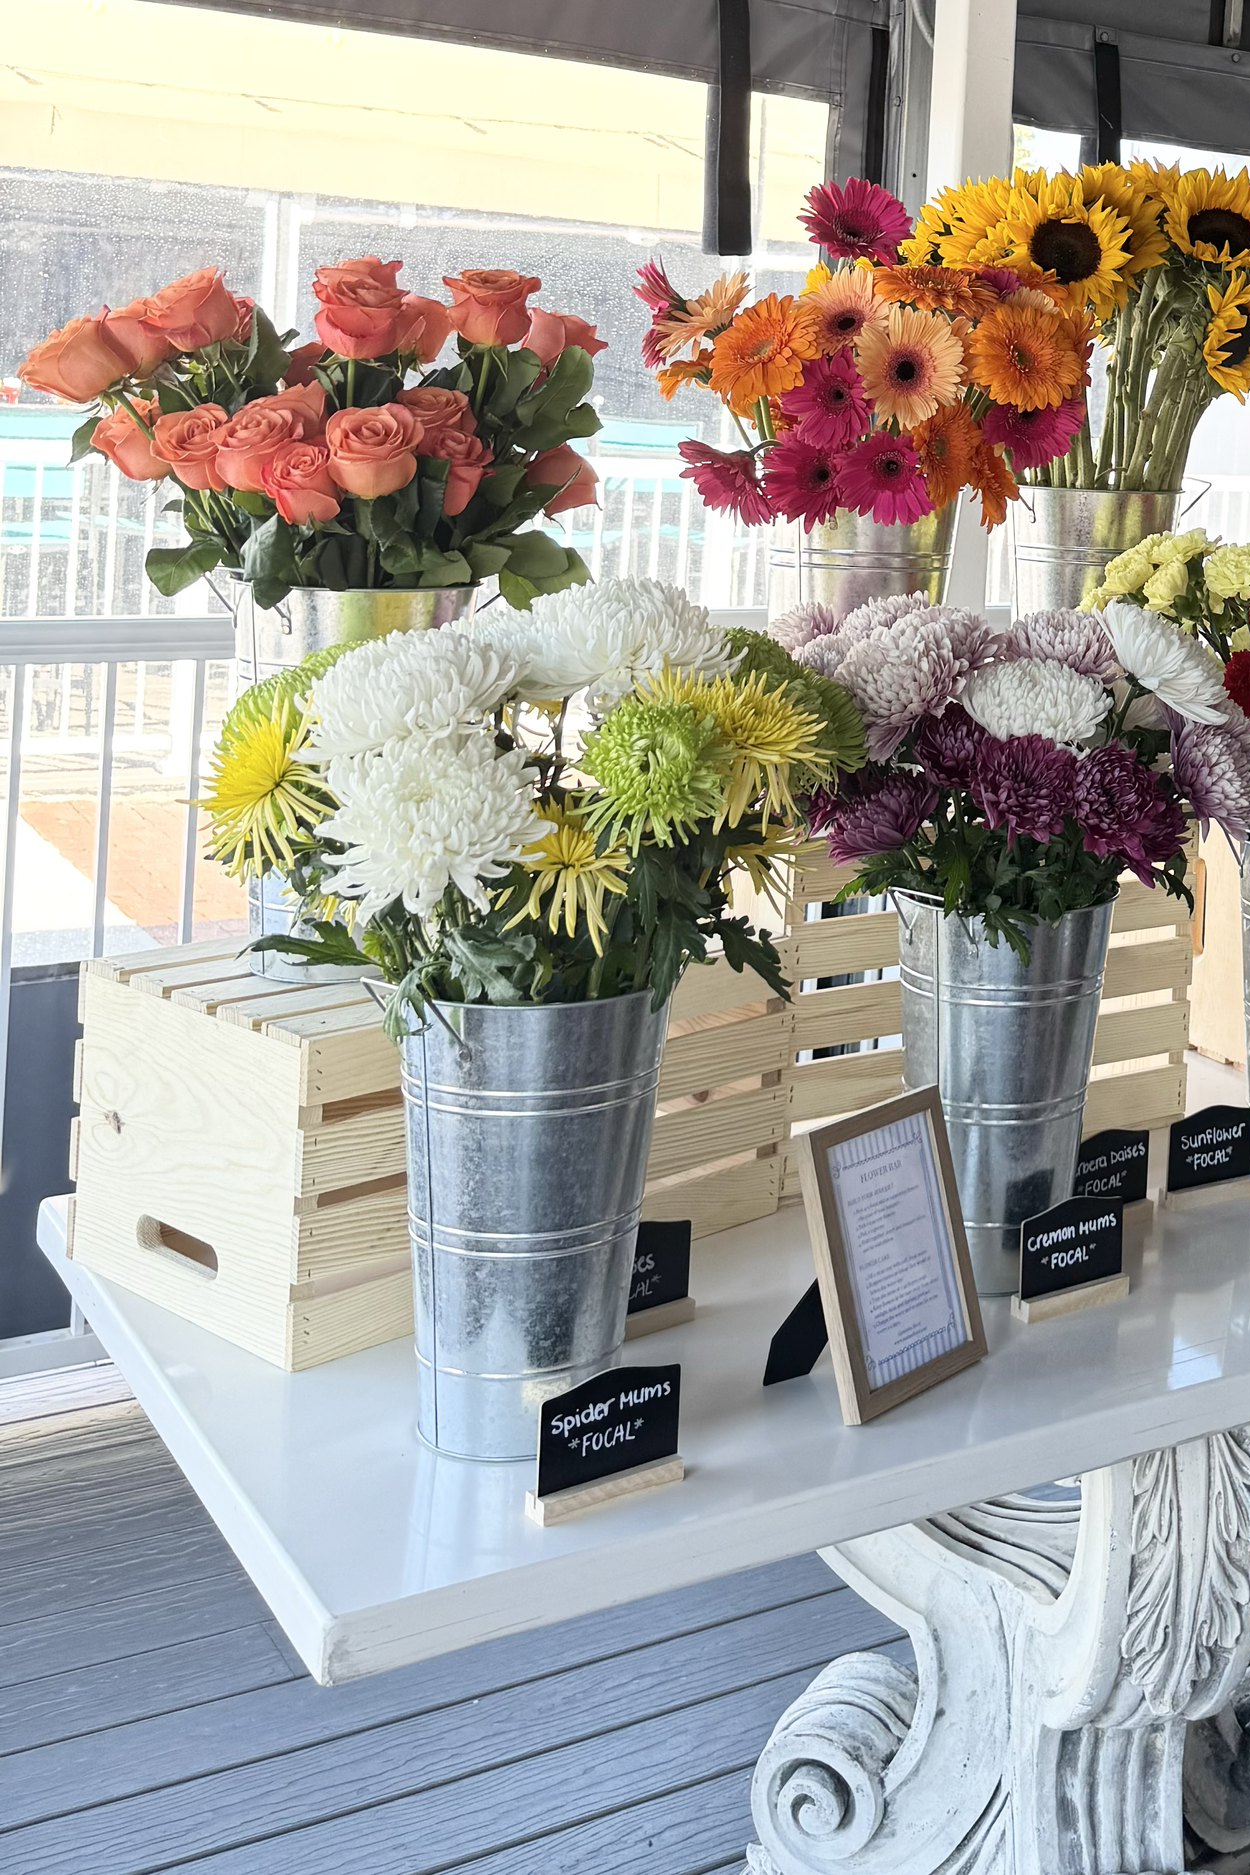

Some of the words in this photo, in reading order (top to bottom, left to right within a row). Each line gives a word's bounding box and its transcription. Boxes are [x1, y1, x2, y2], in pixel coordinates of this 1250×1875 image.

[1181, 1122, 1246, 1150] Sunflower
[1110, 1142, 1146, 1165] Daises
[860, 1165, 888, 1183] FLOWER
[888, 1160, 903, 1172] BAR
[1027, 1224, 1075, 1252] Cremon
[1079, 1212, 1117, 1235] Mums
[551, 1397, 615, 1437] Spider
[619, 1381, 671, 1410] Mums
